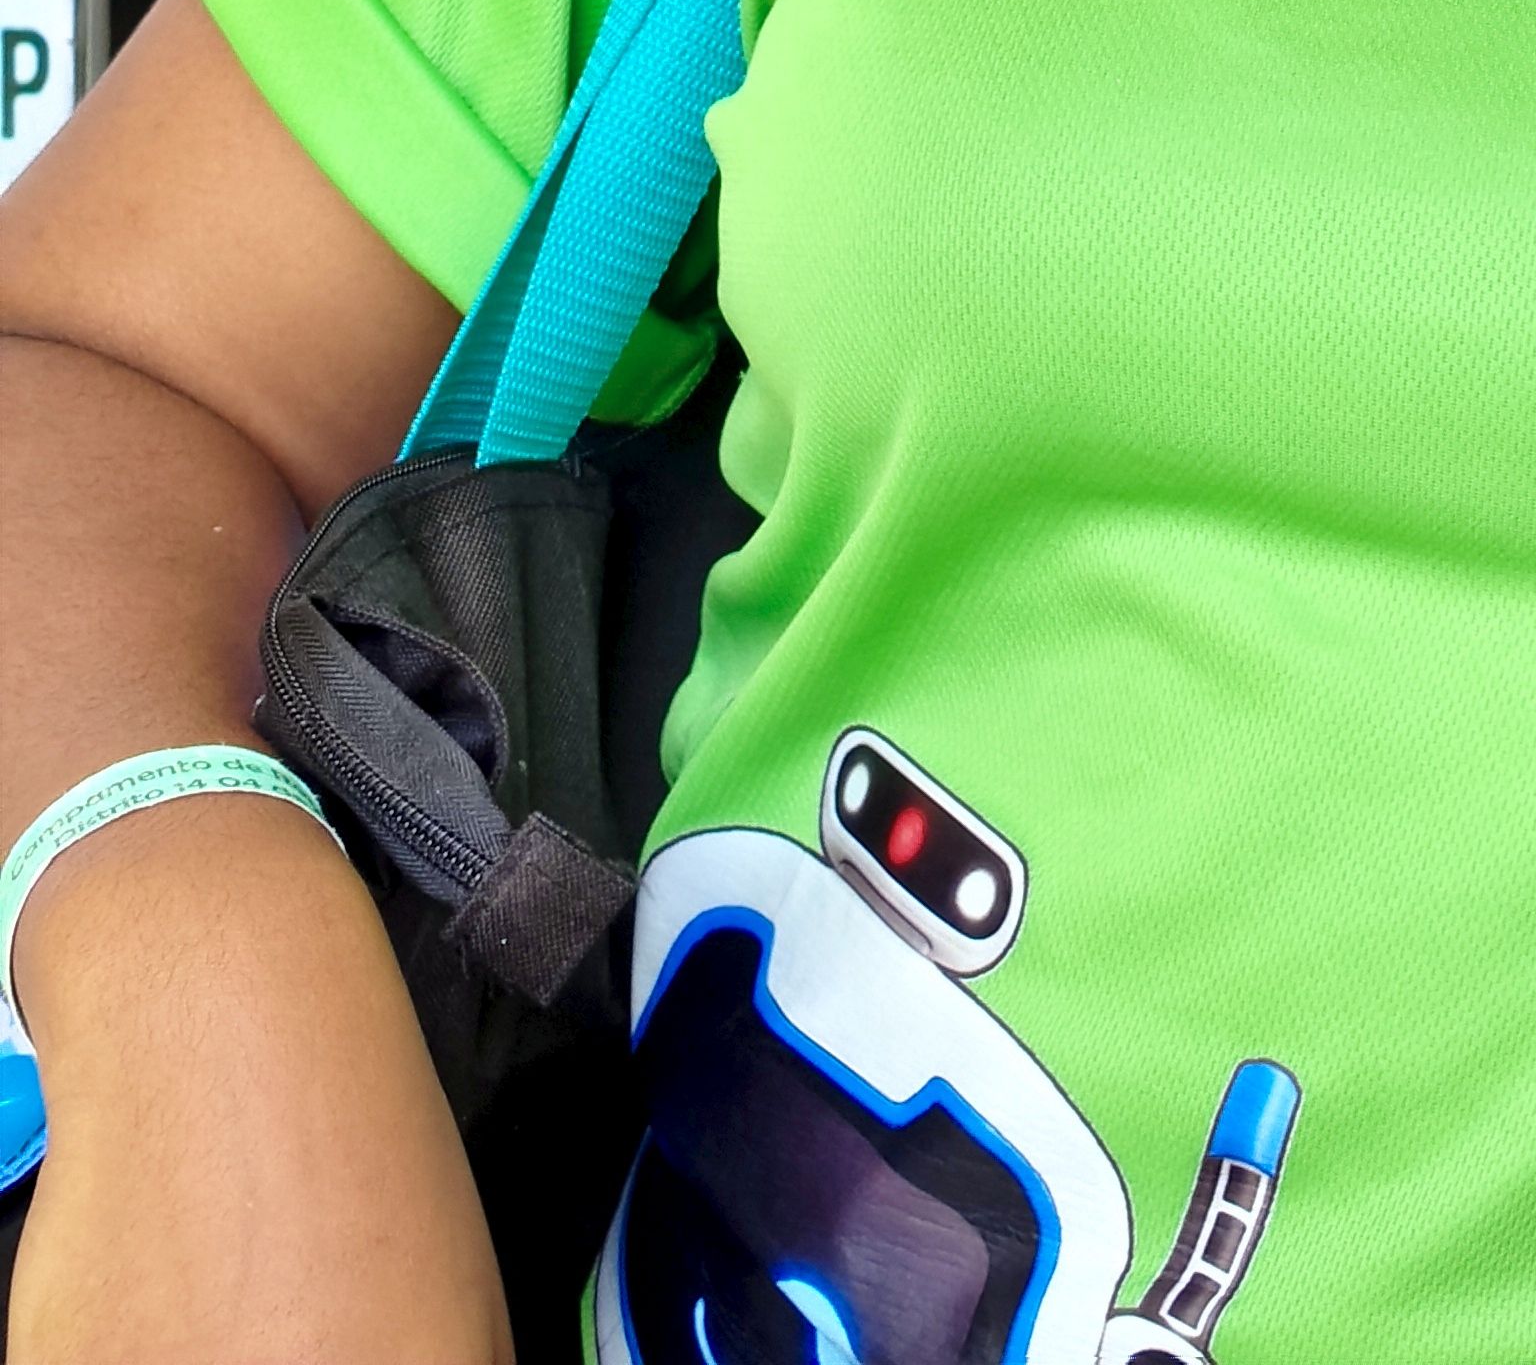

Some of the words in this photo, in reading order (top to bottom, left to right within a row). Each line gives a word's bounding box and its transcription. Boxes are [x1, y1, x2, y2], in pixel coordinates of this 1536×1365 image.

[11, 759, 212, 881] Campamento
[223, 758, 263, 773] de
[53, 788, 164, 848] Distrito
